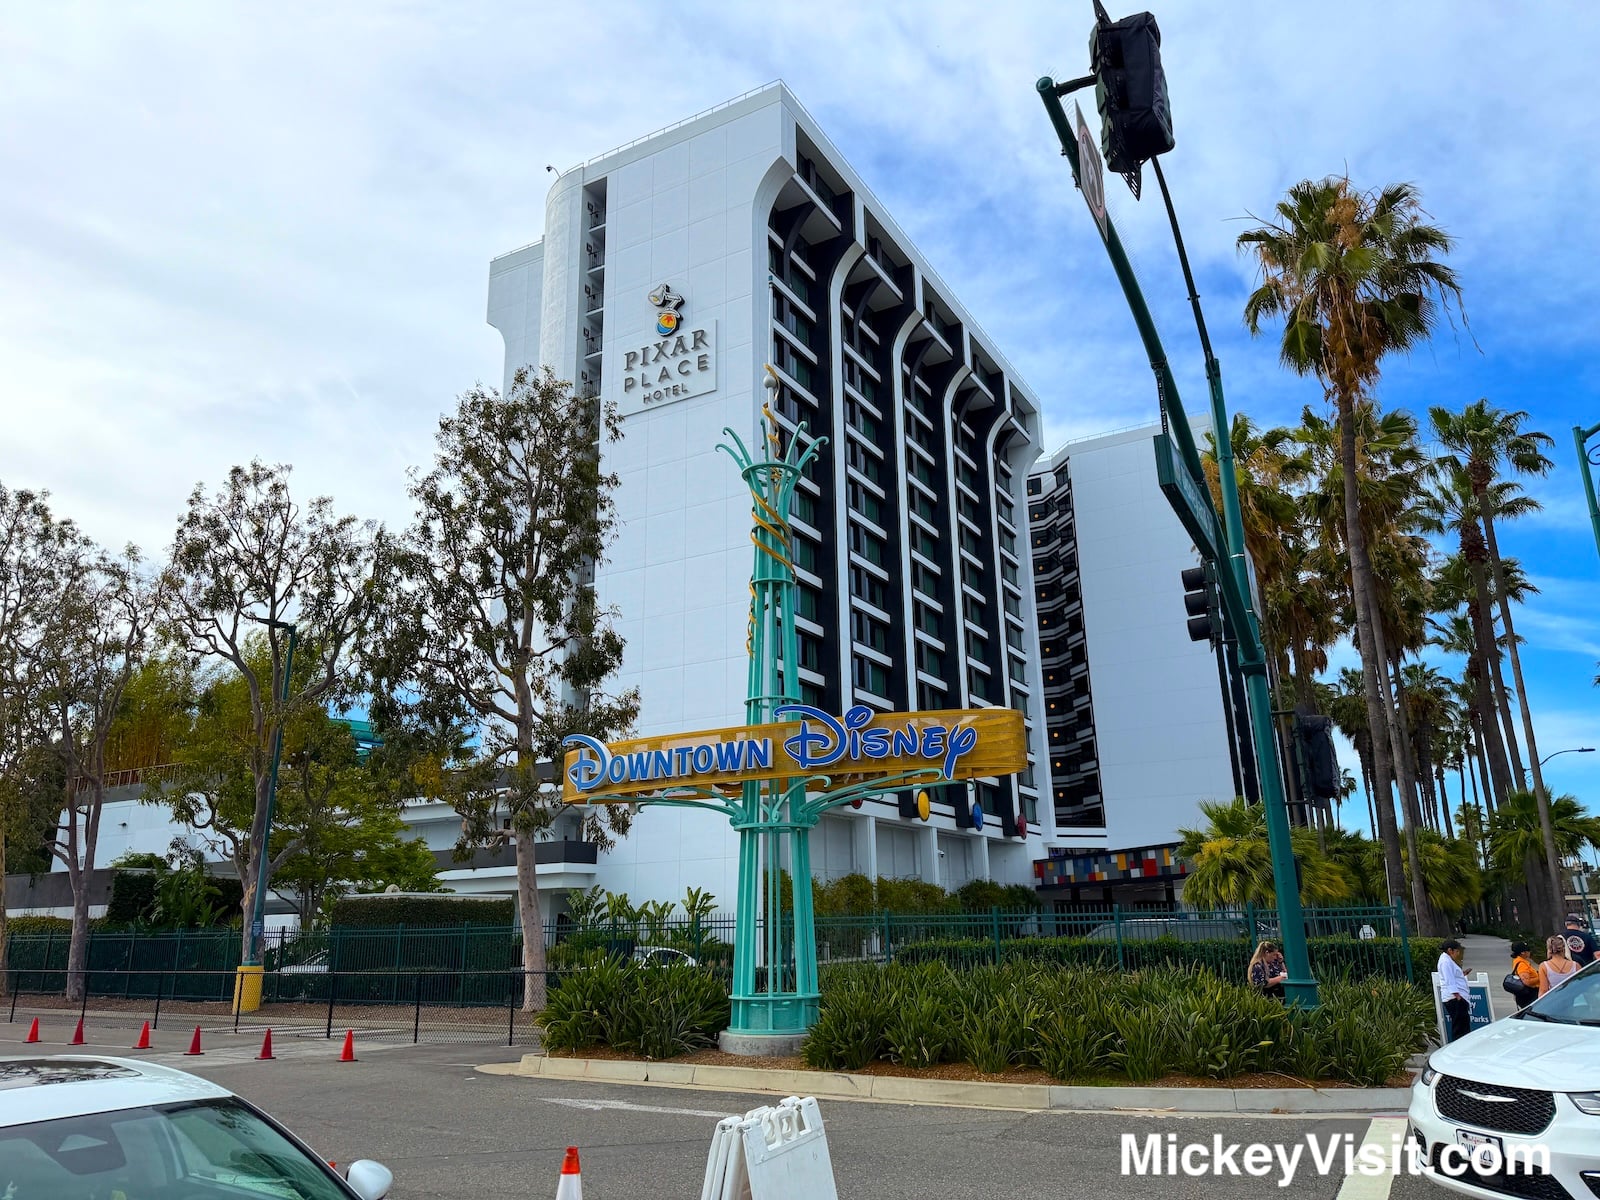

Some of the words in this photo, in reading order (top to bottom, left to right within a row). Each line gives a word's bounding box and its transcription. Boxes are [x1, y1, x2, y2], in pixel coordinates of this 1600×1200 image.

[624, 329, 709, 371] PIXAR
[624, 353, 709, 393] PLACE
[643, 383, 689, 404] HOTEL
[562, 734, 773, 792] DOWNTOWN
[1470, 1015, 1489, 1023] Parks
